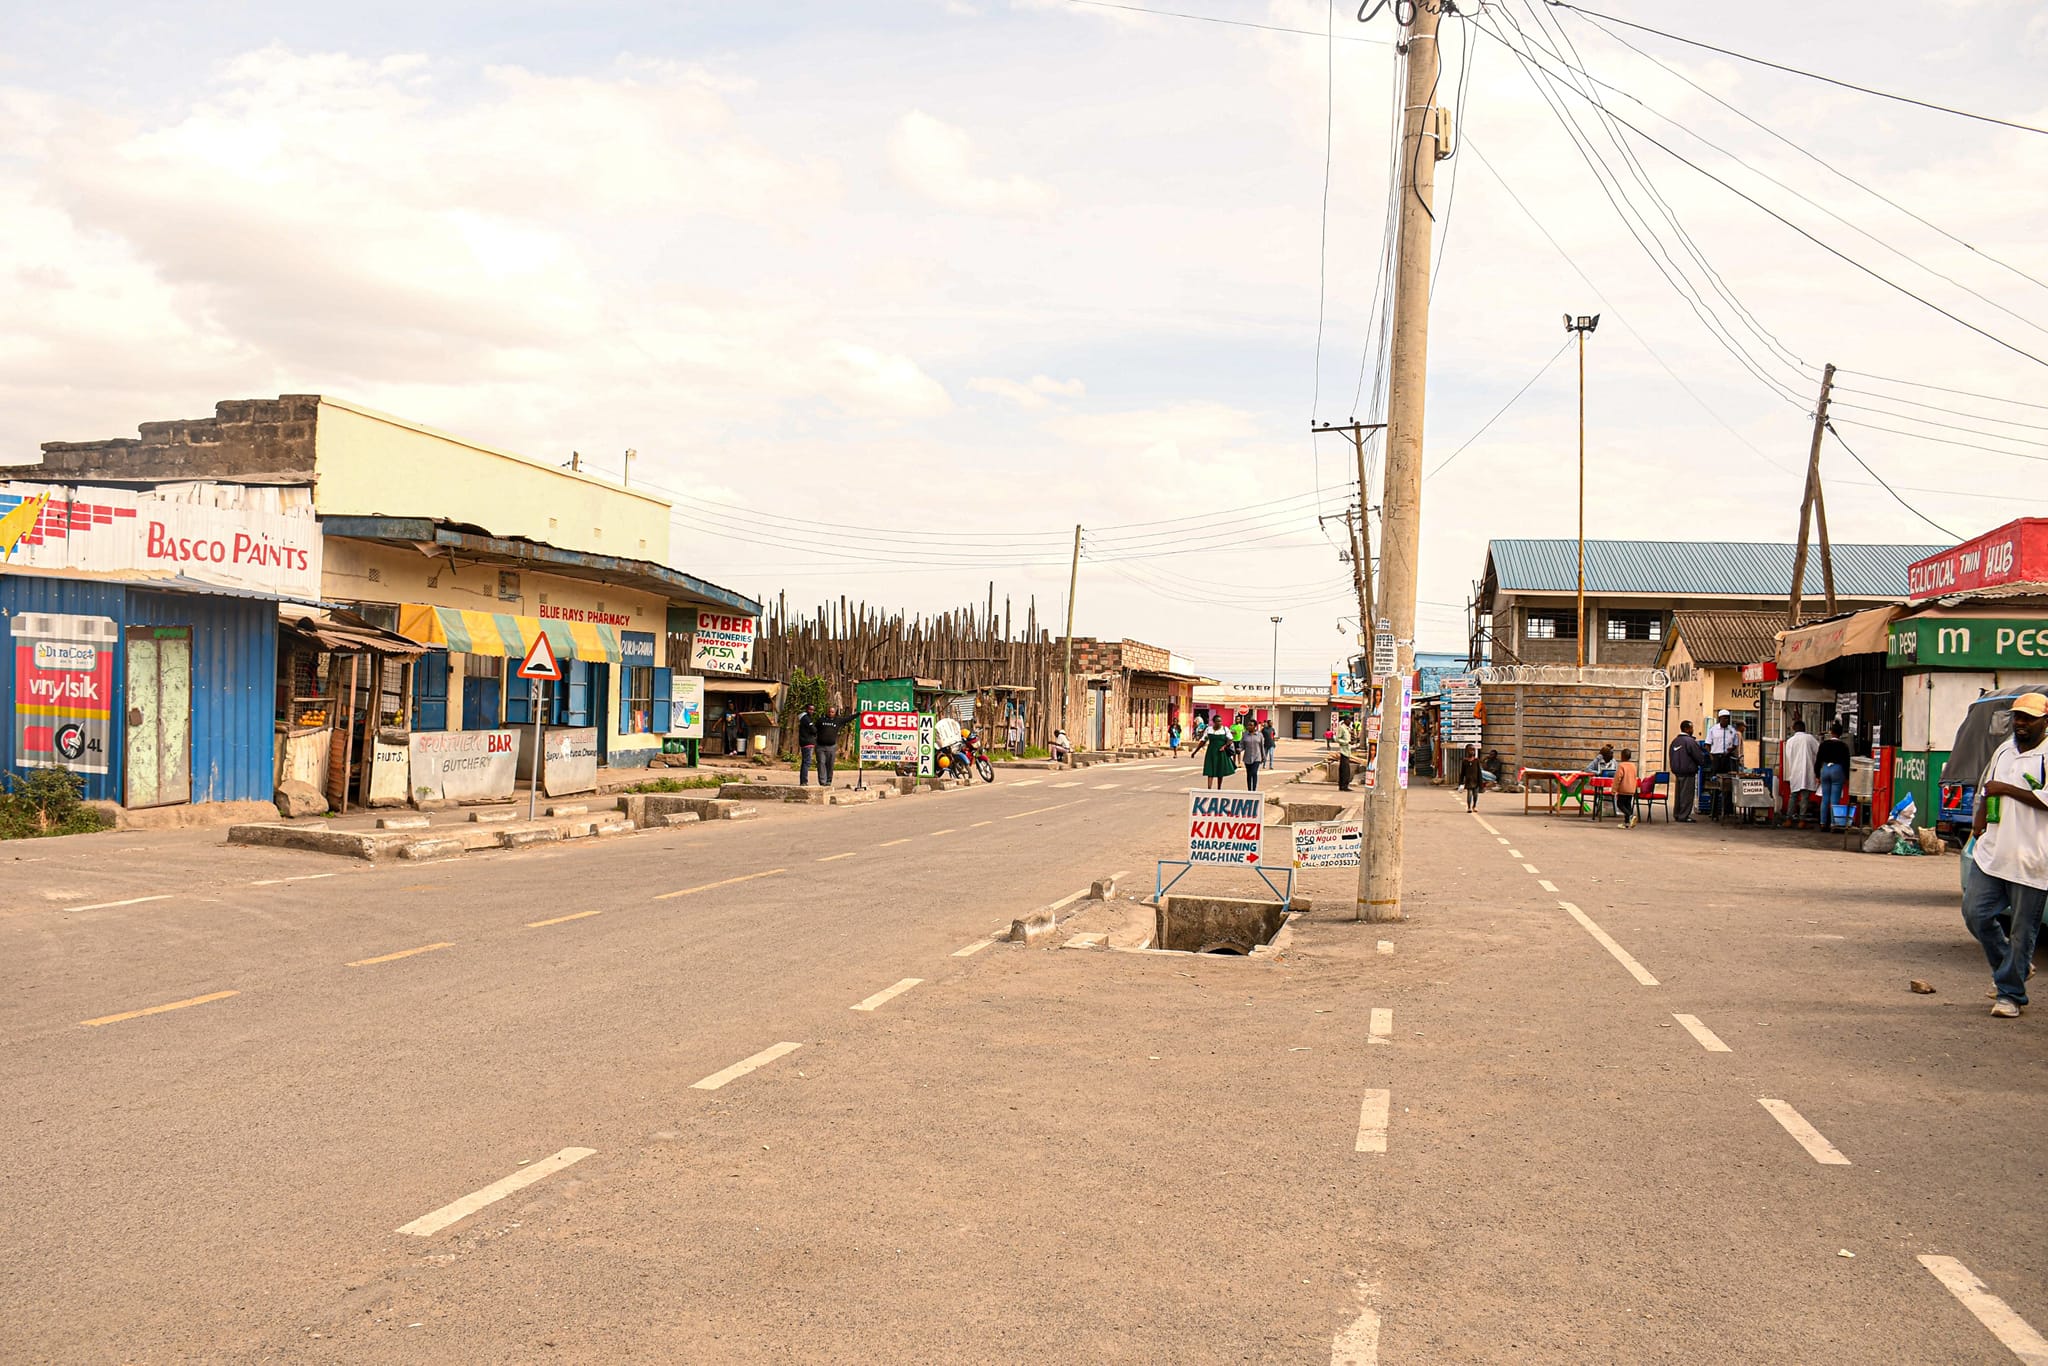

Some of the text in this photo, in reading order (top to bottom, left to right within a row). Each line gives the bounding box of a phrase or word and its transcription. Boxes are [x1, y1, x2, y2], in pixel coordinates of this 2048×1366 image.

[1959, 550, 1981, 575] TWIN
[1985, 541, 2013, 578] HUB
[540, 605, 630, 626] BLUE RAYS PHARMACY
[699, 613, 753, 634] CYBER
[695, 630, 752, 642] STATIONERIES
[1996, 628, 2048, 657] PES
[697, 638, 748, 649] PHOTOCOPY
[1900, 632, 1917, 656] PESA
[719, 662, 742, 672] KRA
[1731, 688, 1760, 699] NAKUR
[863, 714, 918, 727] CYBER
[875, 732, 914, 741] eCitizen
[87, 739, 102, 752] 4L
[487, 734, 513, 753] BAR
[442, 756, 492, 773] BUTCHERY
[1192, 797, 1260, 818] KARIMI
[1190, 820, 1261, 840] KINYOZI
[1190, 840, 1257, 852] SHARPENING
[1190, 851, 1245, 863] MACHINE
[1310, 853, 1331, 861] Wear
